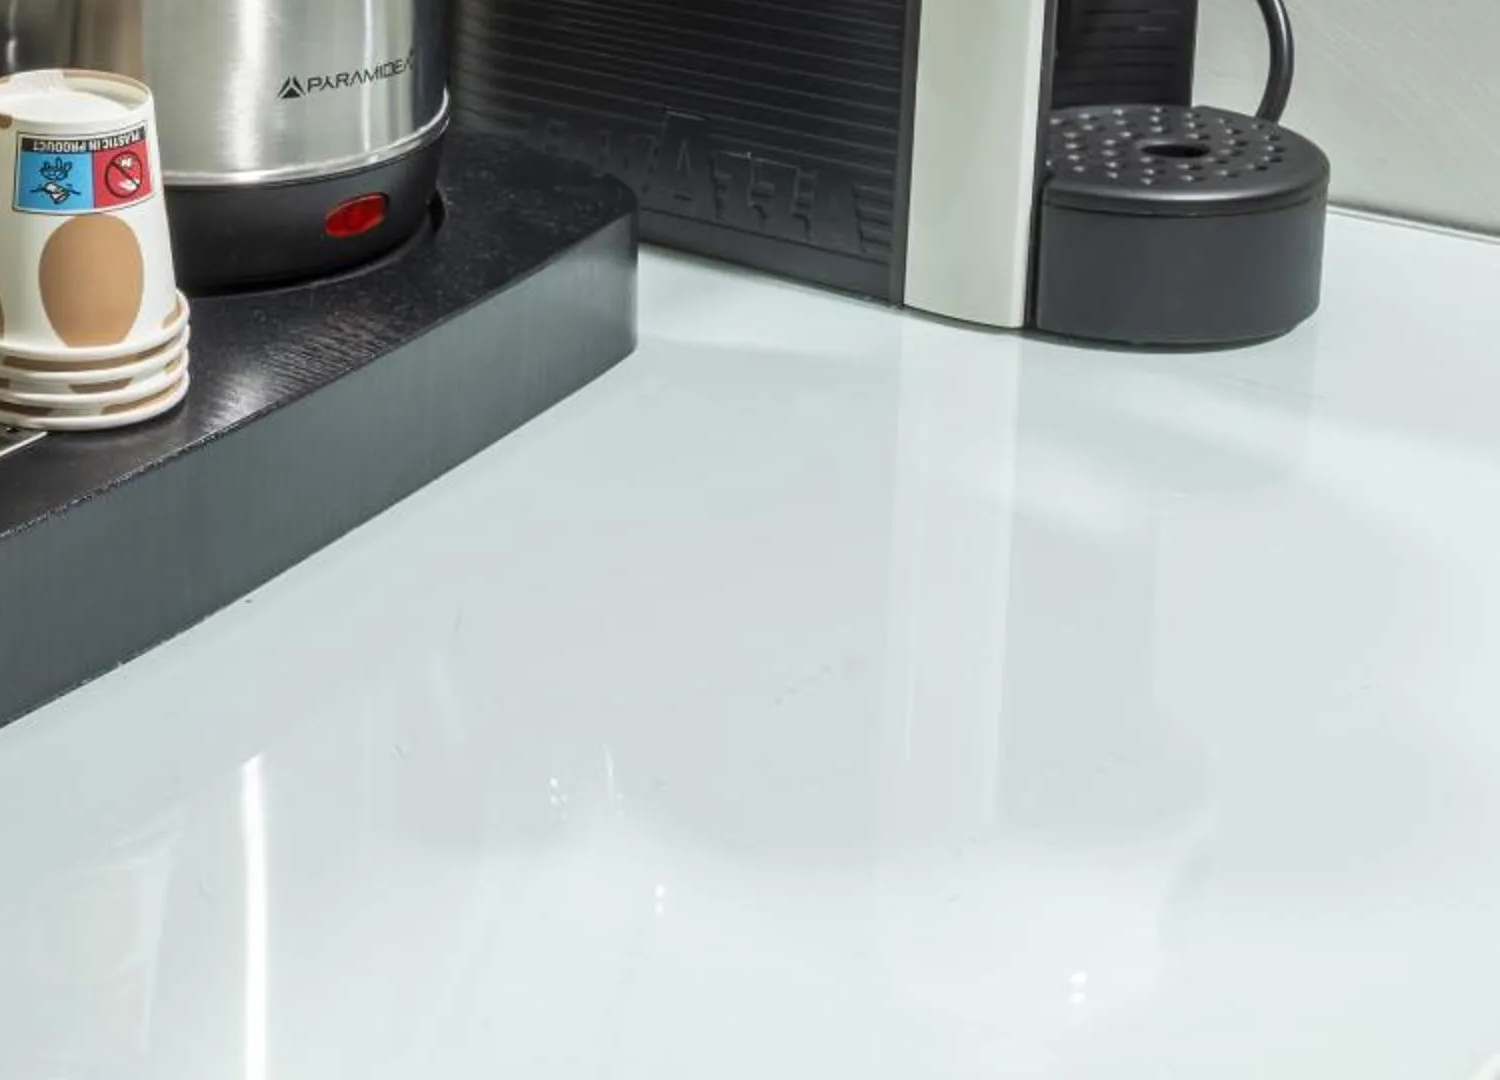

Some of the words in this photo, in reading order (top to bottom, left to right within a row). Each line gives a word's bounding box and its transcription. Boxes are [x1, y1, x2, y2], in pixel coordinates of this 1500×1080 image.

[33, 139, 86, 153] PRODUCT
[89, 138, 101, 151] IN
[102, 128, 140, 150] PLASTIC
